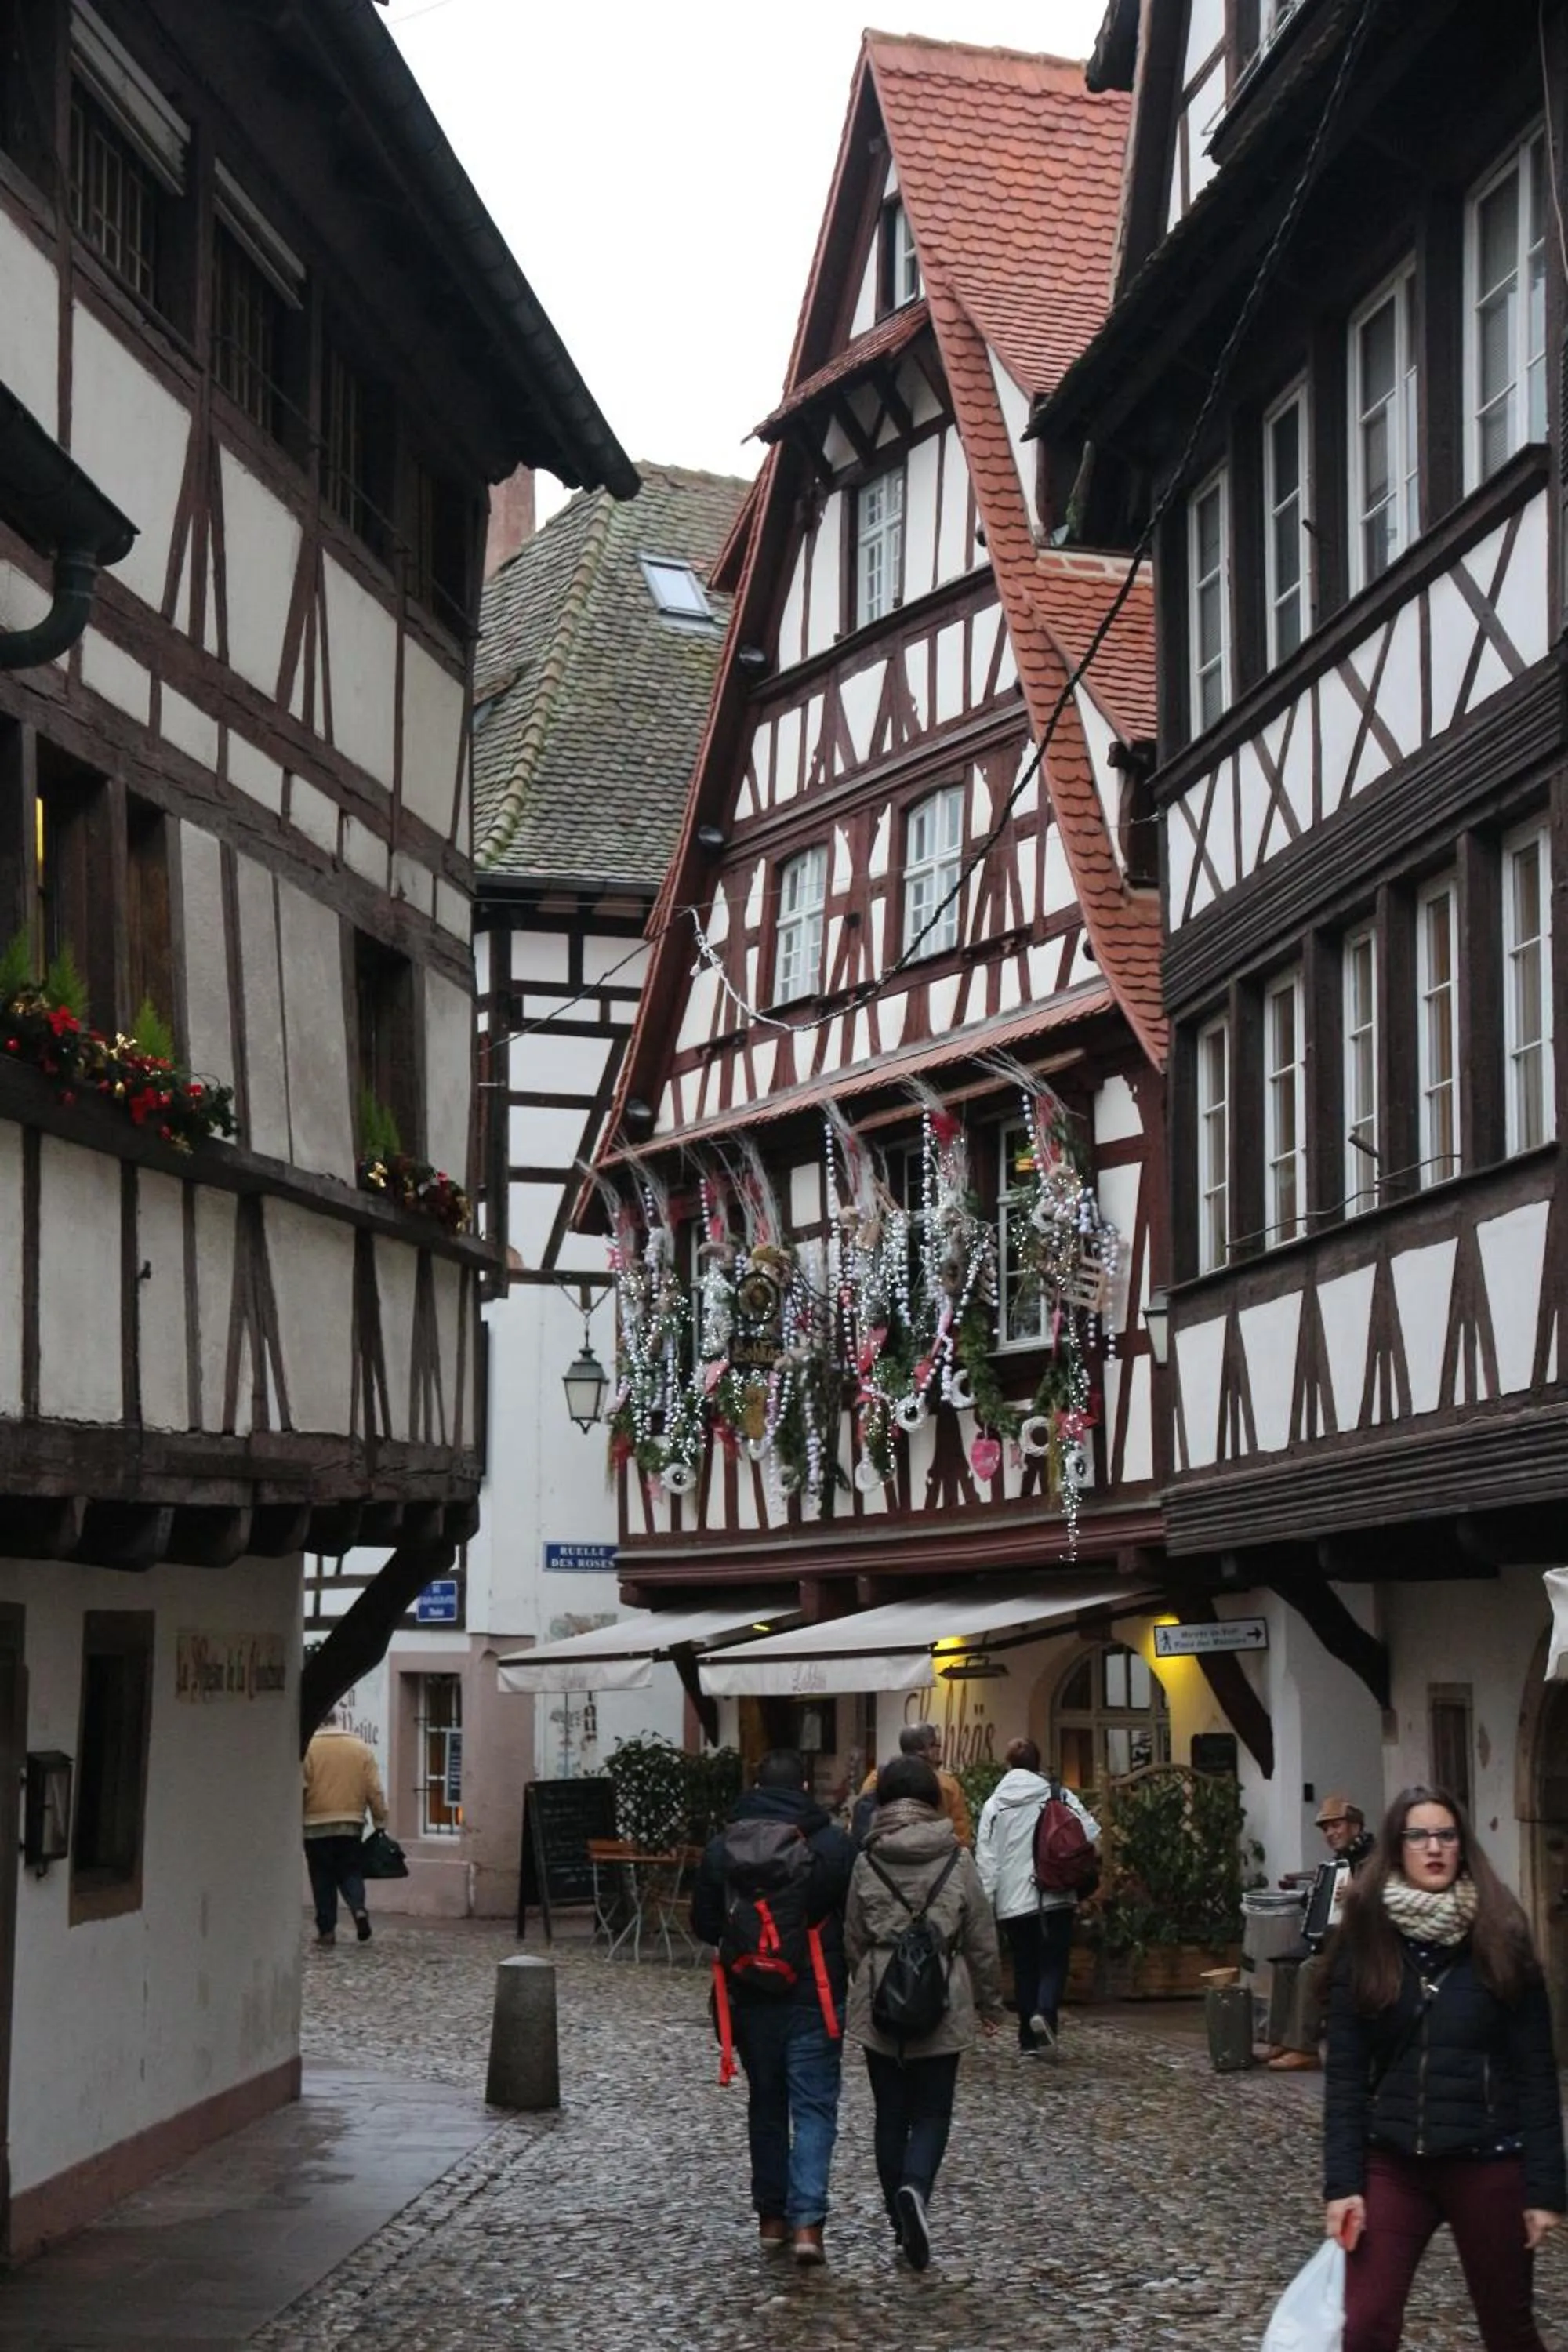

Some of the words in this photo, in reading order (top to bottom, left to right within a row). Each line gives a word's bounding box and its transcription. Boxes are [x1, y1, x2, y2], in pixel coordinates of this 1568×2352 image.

[560, 1546, 606, 1556] RUELLE
[551, 1558, 574, 1567] DES
[577, 1558, 615, 1569] ROSES
